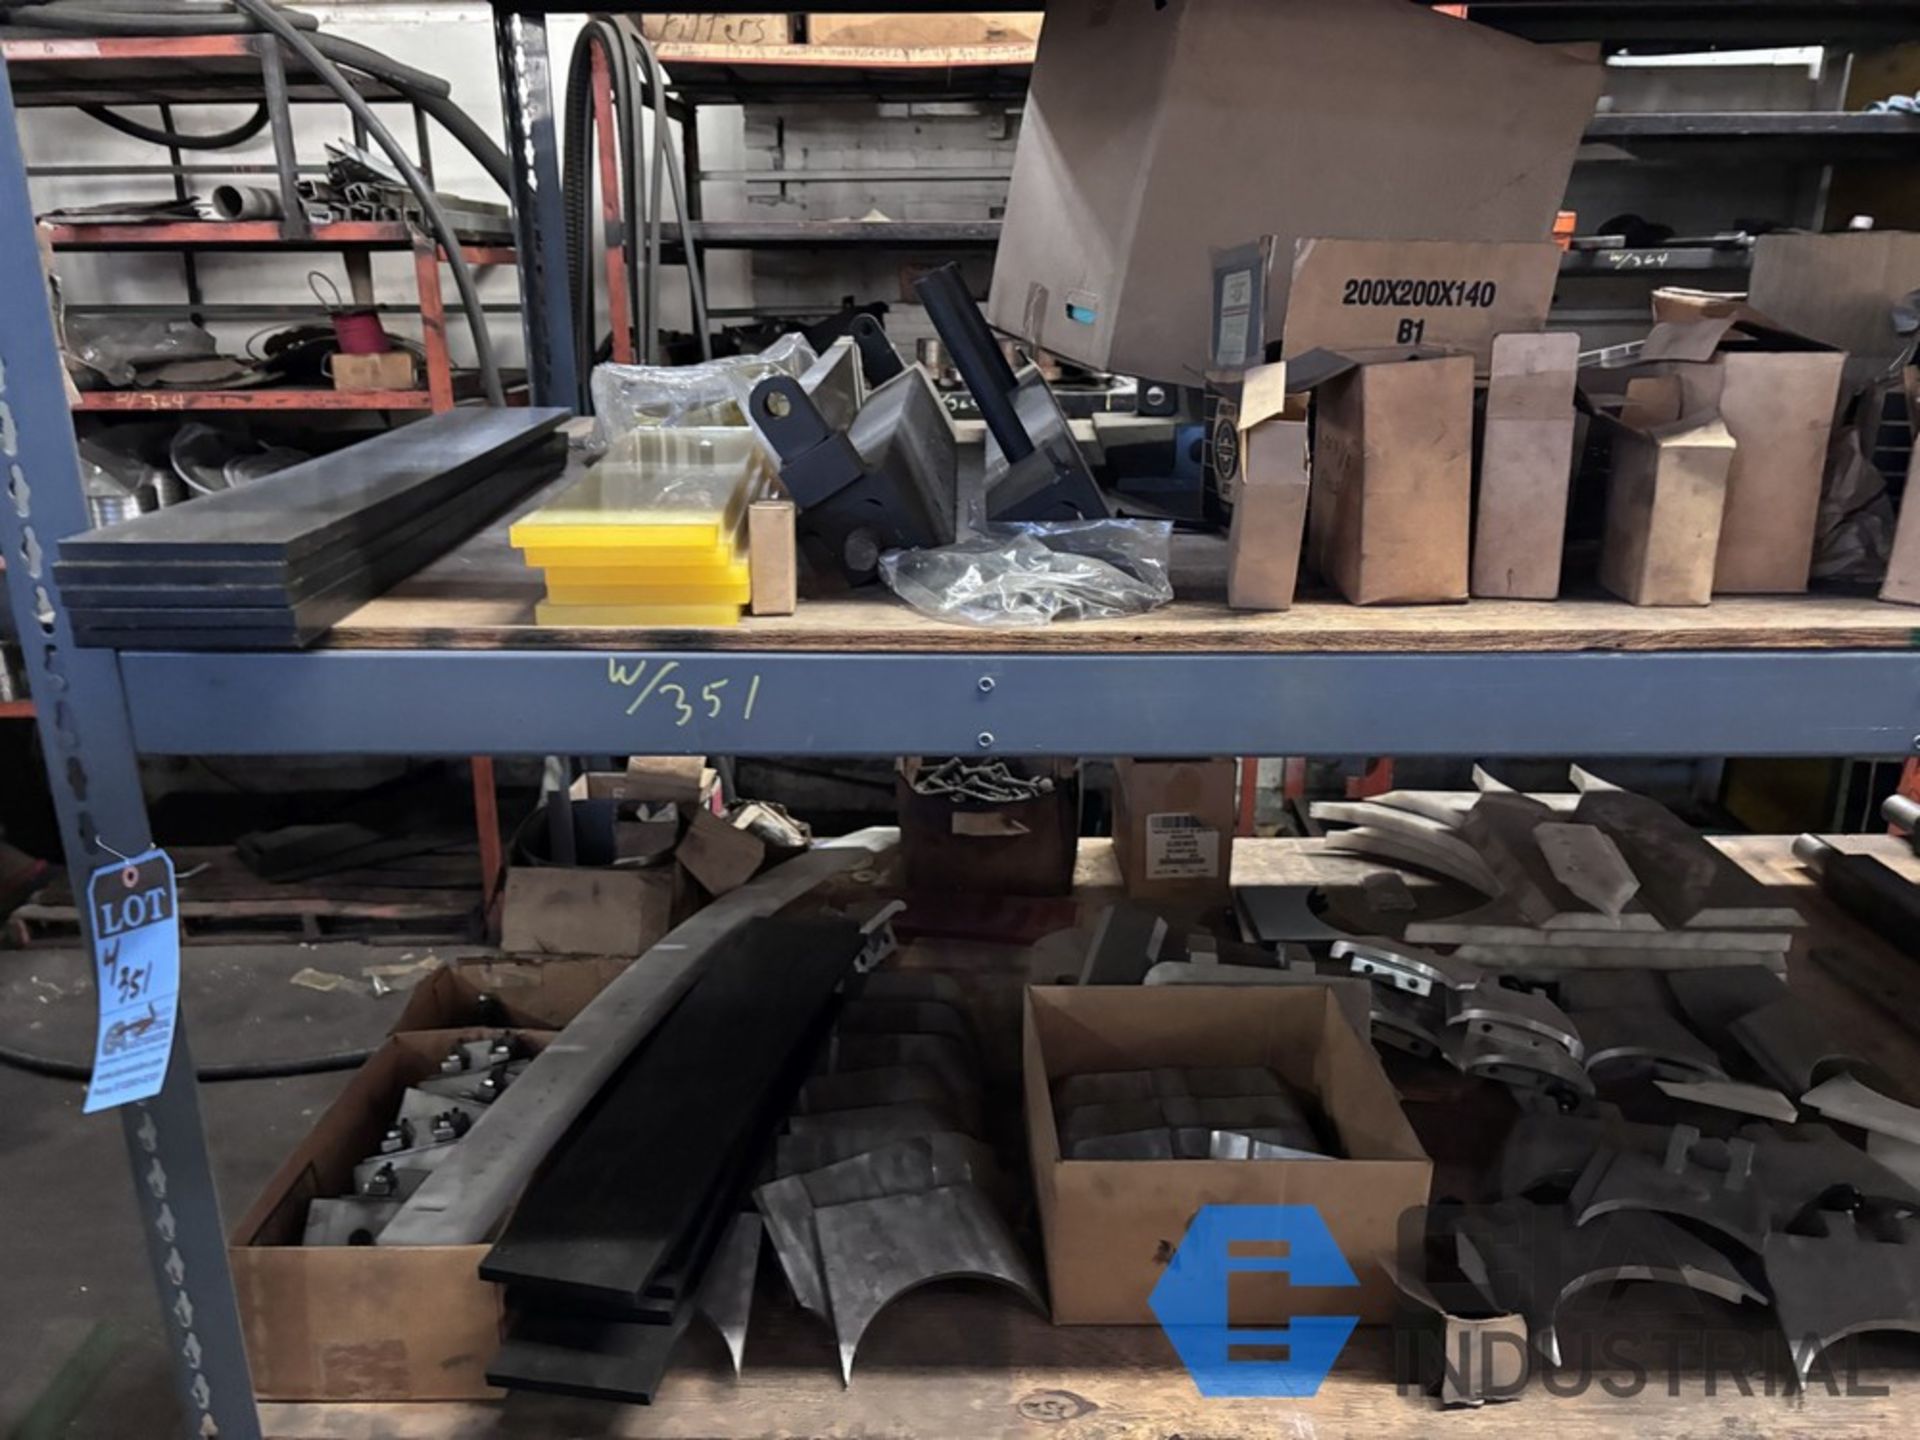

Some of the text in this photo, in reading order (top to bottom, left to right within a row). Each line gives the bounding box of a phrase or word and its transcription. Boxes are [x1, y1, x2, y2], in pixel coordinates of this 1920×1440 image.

[1343, 279, 1497, 307] 200X200X140
[1397, 319, 1425, 345] B1
[608, 657, 761, 726] W/351
[101, 887, 166, 934] LOT
